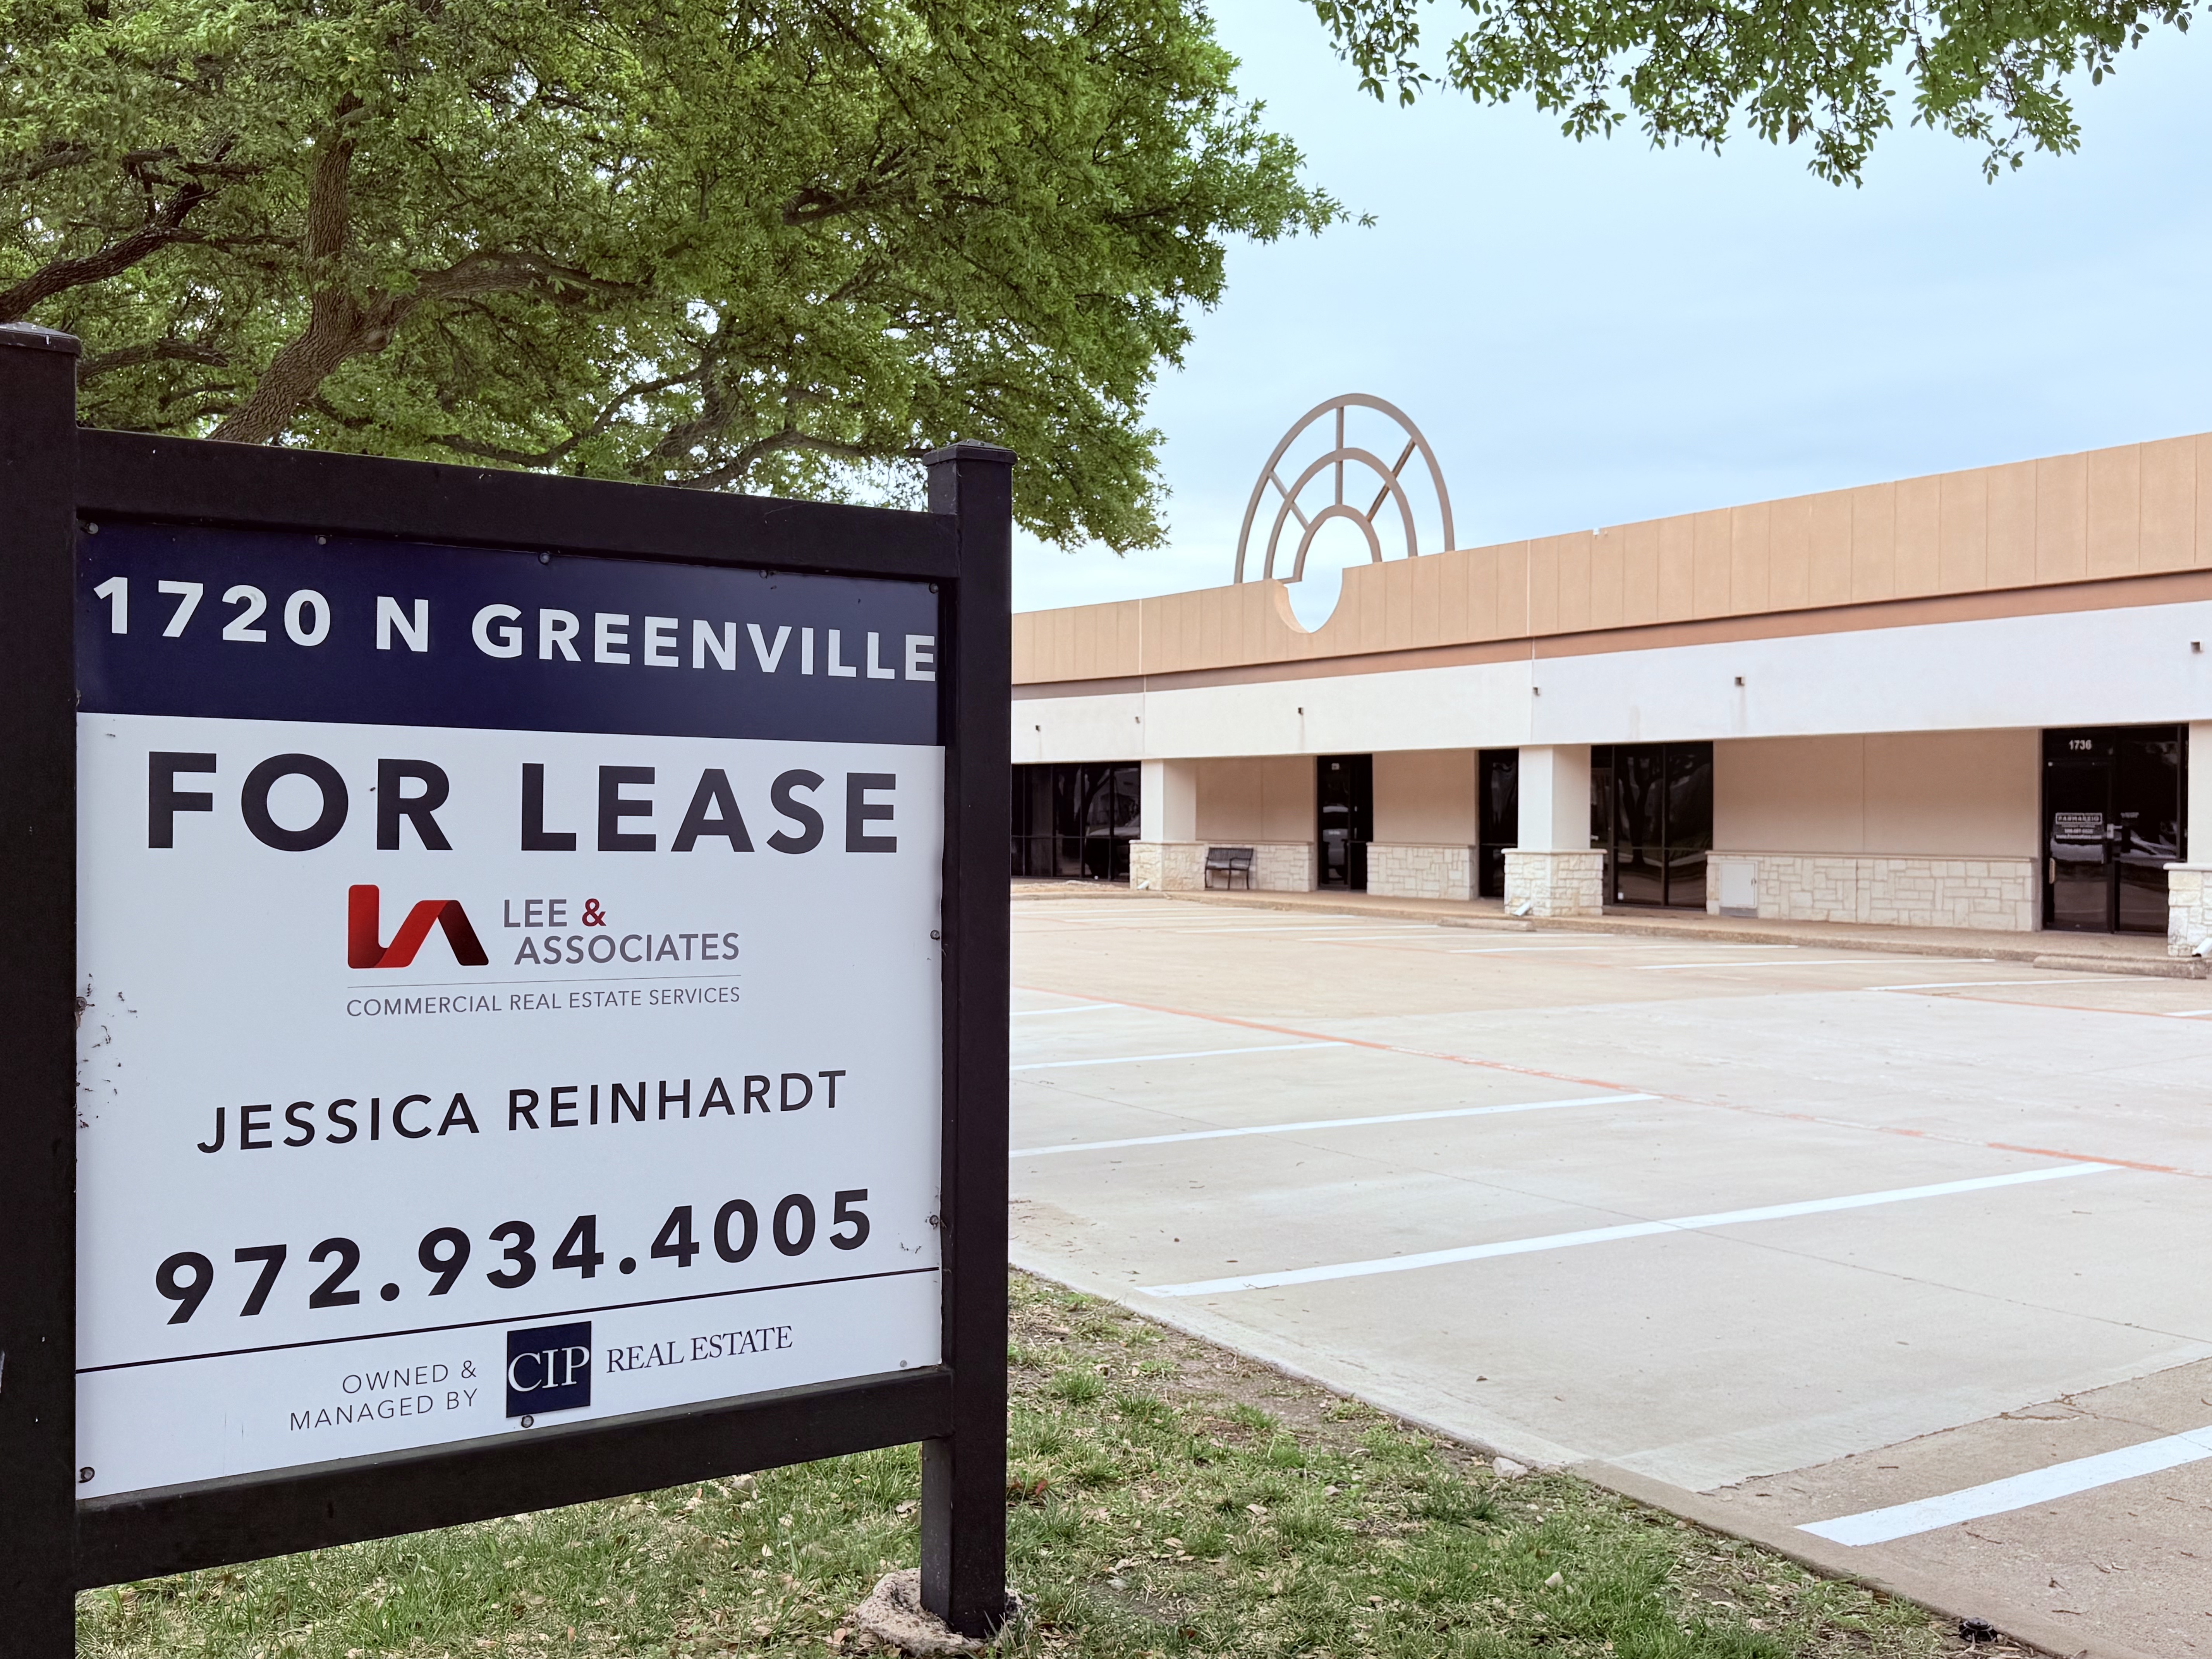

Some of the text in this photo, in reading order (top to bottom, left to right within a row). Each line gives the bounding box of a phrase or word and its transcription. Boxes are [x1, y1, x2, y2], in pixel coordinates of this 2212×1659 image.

[93, 577, 936, 682] 1720 N GREENVILLE
[2069, 739, 2092, 750] 1736
[148, 751, 897, 854] FOR LEASE
[504, 898, 606, 928] LEE &
[514, 933, 739, 965] ASSOCIATES
[347, 987, 739, 1017] COMMERCIAL REAL ESTATE SERVICES
[197, 1070, 846, 1153] JESSICA REINHARDT
[156, 1188, 871, 1326] 972.934.4005
[508, 1346, 590, 1392] CIP
[606, 1326, 793, 1373] REAL ESTATE
[342, 1360, 477, 1394] OWNED &
[290, 1388, 477, 1432] MANAGED BY
